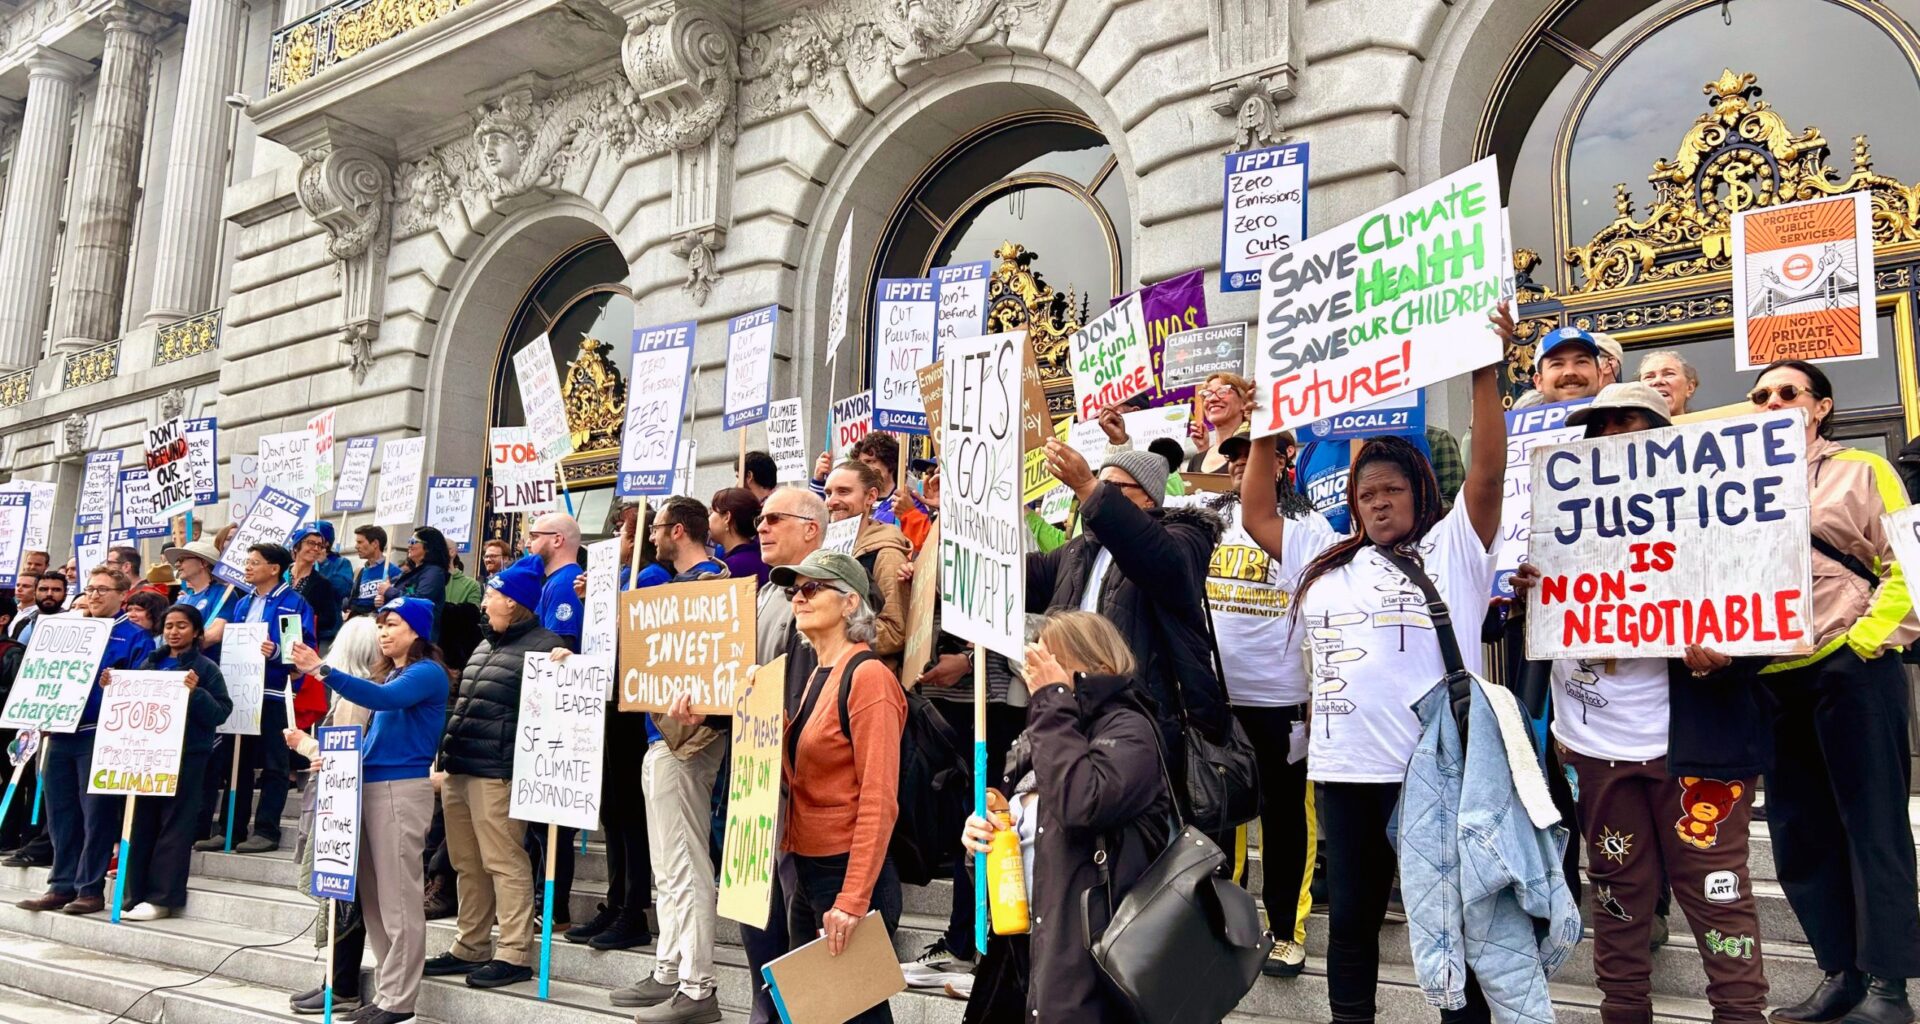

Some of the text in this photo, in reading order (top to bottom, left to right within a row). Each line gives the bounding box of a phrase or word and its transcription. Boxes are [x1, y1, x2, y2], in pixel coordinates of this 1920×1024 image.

[1236, 148, 1298, 172] IFPTE
[1231, 175, 1272, 194] Zero
[1234, 213, 1278, 234] Zero
[1763, 210, 1816, 226] PROTECT
[1775, 220, 1816, 234] PUBLIC
[1268, 243, 1357, 298] SAVE
[885, 283, 932, 300] IFPTE
[735, 310, 771, 332] IFPTE
[890, 306, 914, 326] CUT
[1077, 298, 1132, 352] DON'T
[1267, 291, 1353, 339] SAVE
[1789, 316, 1816, 328] NOT
[639, 328, 688, 352] IFPTE
[737, 332, 756, 349] CUT
[1169, 328, 1243, 348] CLIMATE CHANGE
[1772, 324, 1834, 342] PRIVATE
[1079, 325, 1136, 372] defund
[1192, 347, 1212, 357] IS A
[1269, 328, 1349, 377] SAVE
[1348, 317, 1388, 346] OUR
[1750, 353, 1765, 361] FIX
[1776, 338, 1831, 354] GREED!
[640, 356, 666, 378] ZERO
[736, 360, 756, 382] NOT
[890, 348, 924, 372] NOT
[1094, 354, 1126, 387] our
[1167, 360, 1241, 378] HEALTH EMERGENCY
[950, 340, 1014, 440] LET'S
[1082, 366, 1148, 418] FUTURE
[629, 400, 668, 430] ZERO
[736, 406, 764, 422] LOCAL 21
[770, 404, 797, 418] CLIMATE
[834, 394, 870, 424] MAYOR
[890, 413, 916, 426] LOCAL
[931, 409, 940, 424] IT
[769, 419, 797, 434] JUSTICE
[1334, 412, 1408, 430] LOCAL 21
[290, 438, 310, 452] CUT
[386, 443, 404, 458] YOU
[494, 442, 537, 464] JOB
[634, 430, 674, 460] CUTS!
[771, 450, 804, 462] NEGOTIABLE
[1546, 418, 1797, 492] CLIMATE
[157, 462, 180, 486] OUR
[288, 470, 304, 482] THE
[632, 474, 666, 486] LOCAL 21
[958, 437, 988, 504] GO
[125, 483, 150, 494] Fund
[381, 484, 414, 502] CLIMATE
[434, 479, 472, 487] IFPTE
[494, 480, 556, 507] PLANET
[1308, 476, 1348, 505] UNIO
[152, 478, 193, 514] FUTURE
[264, 490, 302, 515] IFPTE
[377, 502, 413, 518] WORKERS
[436, 504, 468, 514] DEFUND
[1554, 475, 1786, 545] JUSTICE
[944, 493, 1018, 556] SAN FRANCISCO
[83, 530, 129, 545] IFTE
[1628, 541, 1677, 573] IS
[943, 538, 978, 620] ENV
[1542, 570, 1647, 606] NON-
[630, 584, 740, 633] MAYOR LURIE!
[1384, 596, 1410, 604] Harbor
[1562, 589, 1804, 648] NEGOTIABLE
[35, 624, 96, 656] DUDE,
[646, 630, 746, 666] INVEST IN
[527, 656, 606, 692] SF CLIMATE
[36, 682, 62, 700] my
[107, 674, 186, 698] PROTECT
[232, 684, 260, 705] ERO
[8, 696, 86, 730] charger?
[556, 694, 602, 717] LEADER
[1330, 702, 1348, 712] Rock
[104, 702, 172, 734] JOBS
[120, 736, 150, 746] that
[324, 730, 357, 750] IFPTE
[522, 726, 542, 752] SF
[753, 714, 780, 749] PLEASE
[97, 746, 178, 769] PROTECT
[320, 756, 336, 772] Cut
[534, 753, 592, 783] CLIMATE
[93, 768, 178, 794] CLIMATE
[731, 756, 771, 802] LEAD ON
[318, 796, 334, 811] NOT
[518, 778, 597, 814] BYSTANDER
[322, 818, 352, 834] Climate
[324, 878, 350, 890] LOCAL 21
[1710, 886, 1732, 896] ART
